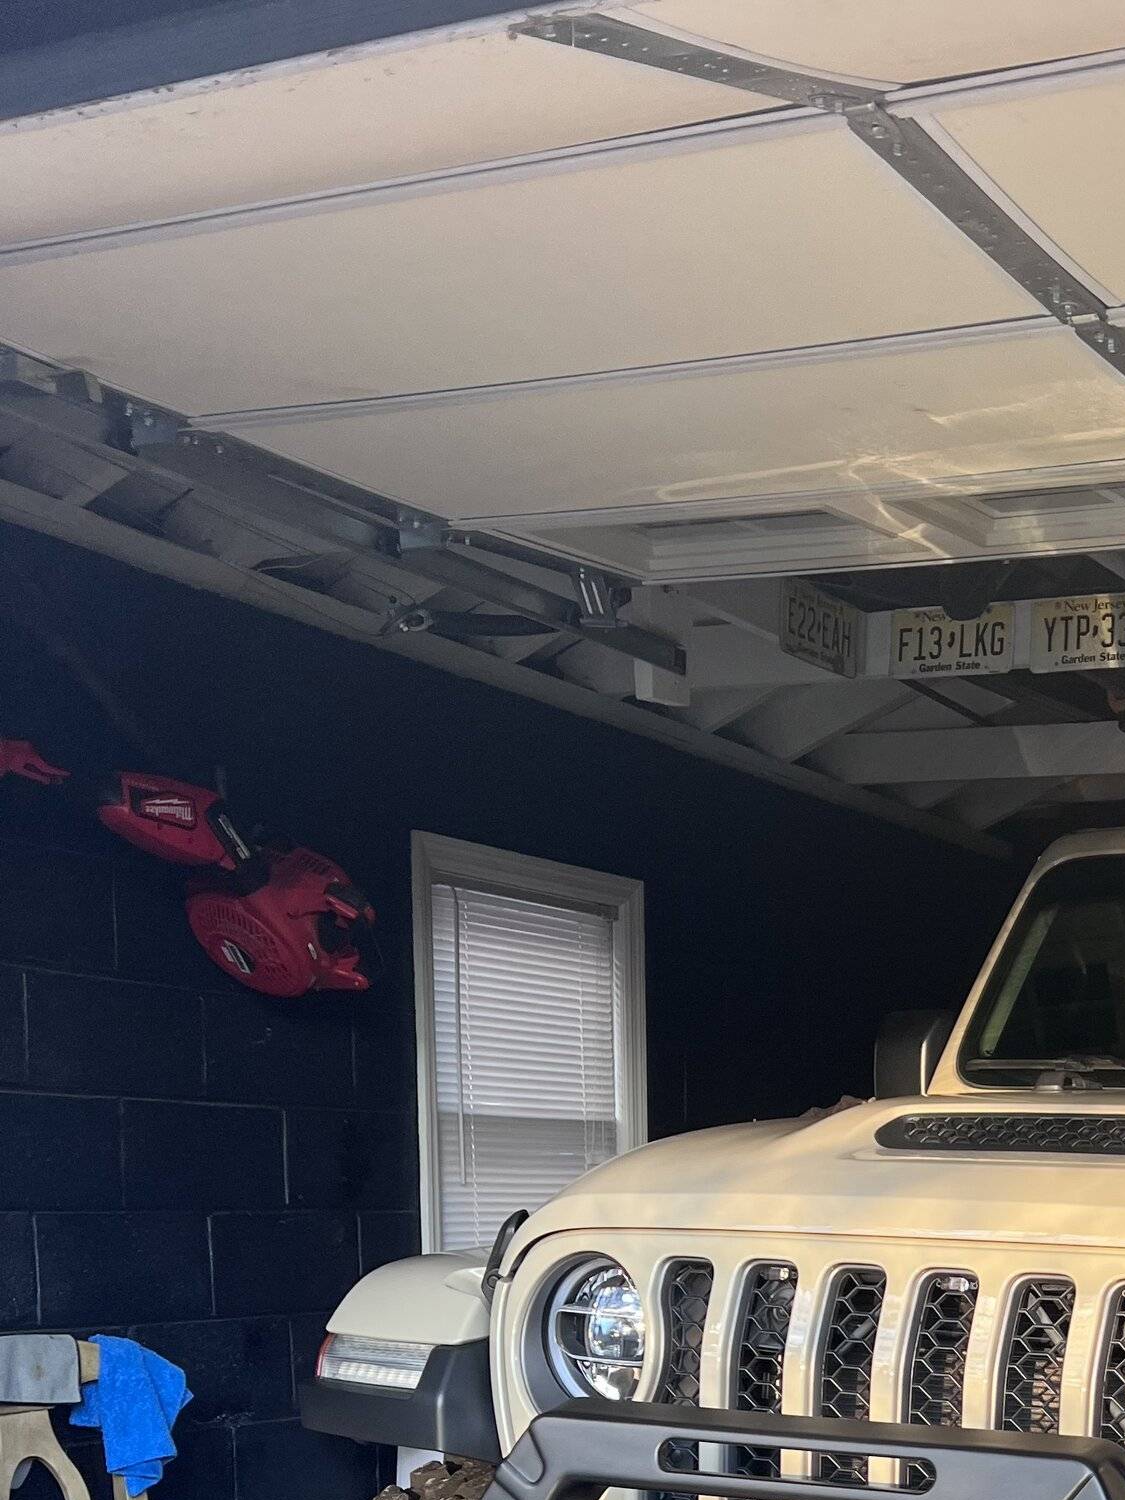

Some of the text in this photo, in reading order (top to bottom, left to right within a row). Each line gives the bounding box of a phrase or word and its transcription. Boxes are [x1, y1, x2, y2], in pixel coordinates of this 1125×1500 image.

[1064, 599, 1091, 611] New
[1062, 652, 1125, 664] Garden State
[919, 661, 981, 673] Garden State
